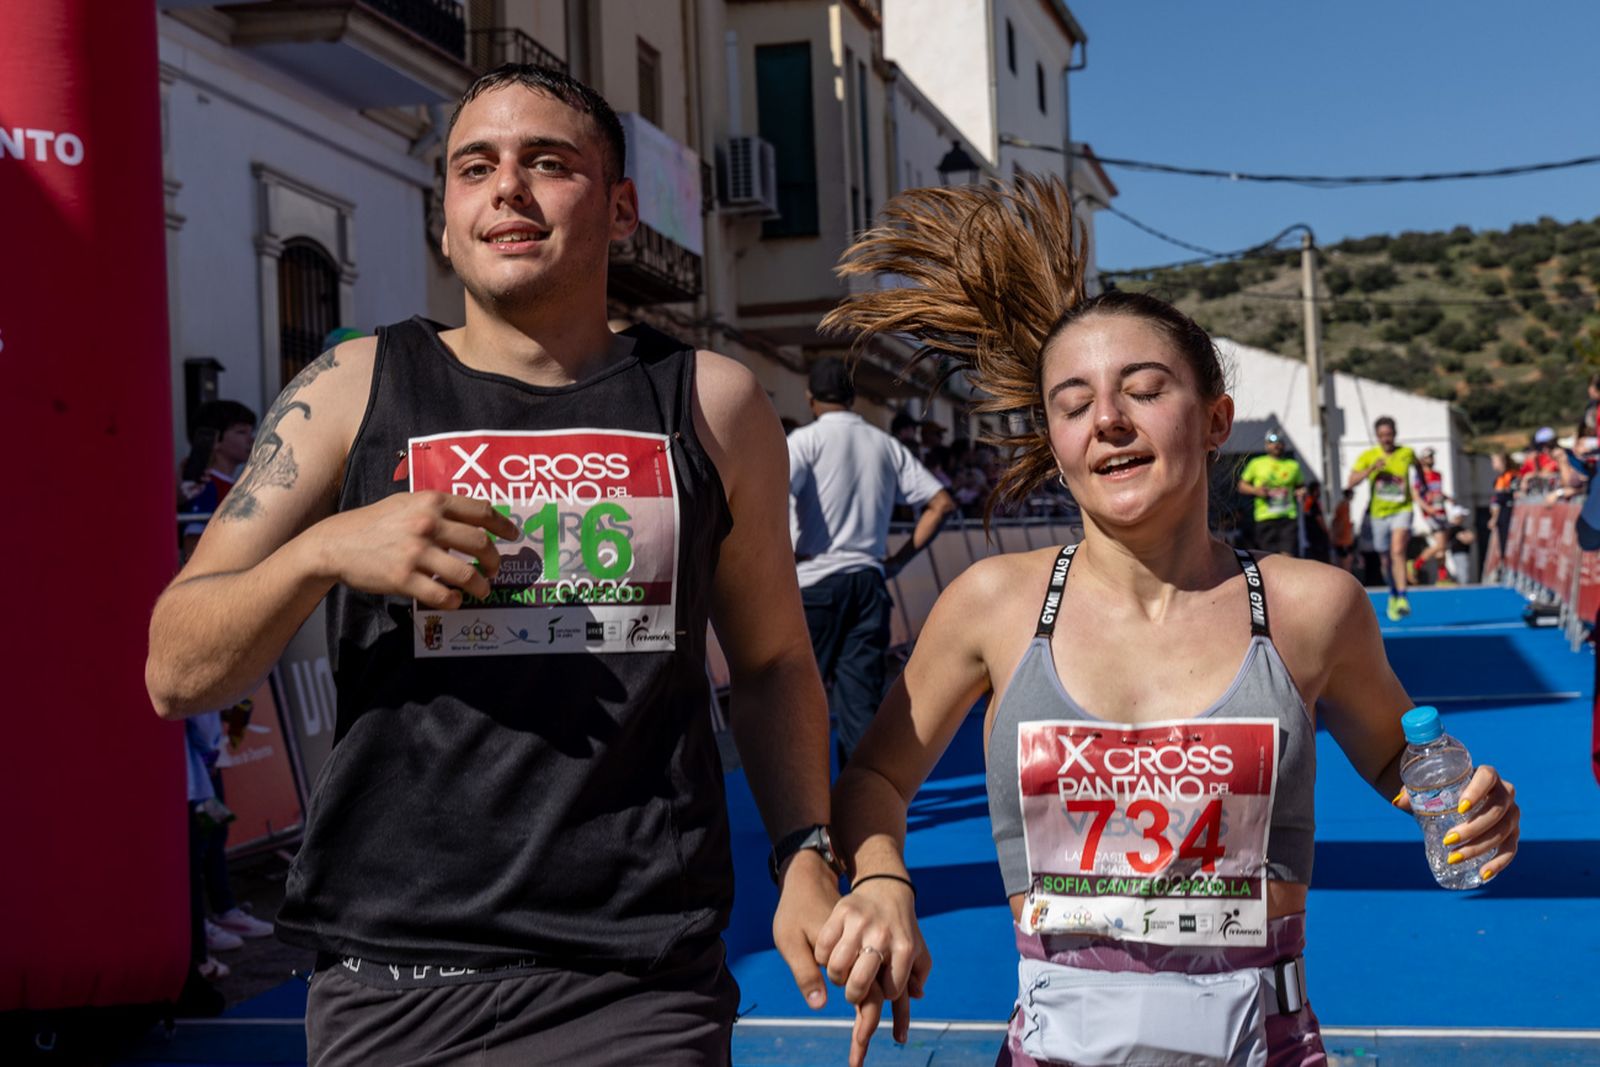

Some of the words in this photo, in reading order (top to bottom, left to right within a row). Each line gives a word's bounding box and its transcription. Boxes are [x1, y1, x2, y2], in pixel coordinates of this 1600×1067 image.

[450, 443, 491, 480] X
[499, 452, 630, 481] CROSS
[451, 480, 602, 507] PANTANO
[606, 486, 632, 498] DEL
[1057, 734, 1097, 775] X
[1103, 745, 1234, 775] CROSS
[1057, 776, 1204, 803] PANTANO
[1208, 783, 1232, 796] DEL
[1066, 798, 1225, 873] 734
[1043, 876, 1092, 894] SOFIA
